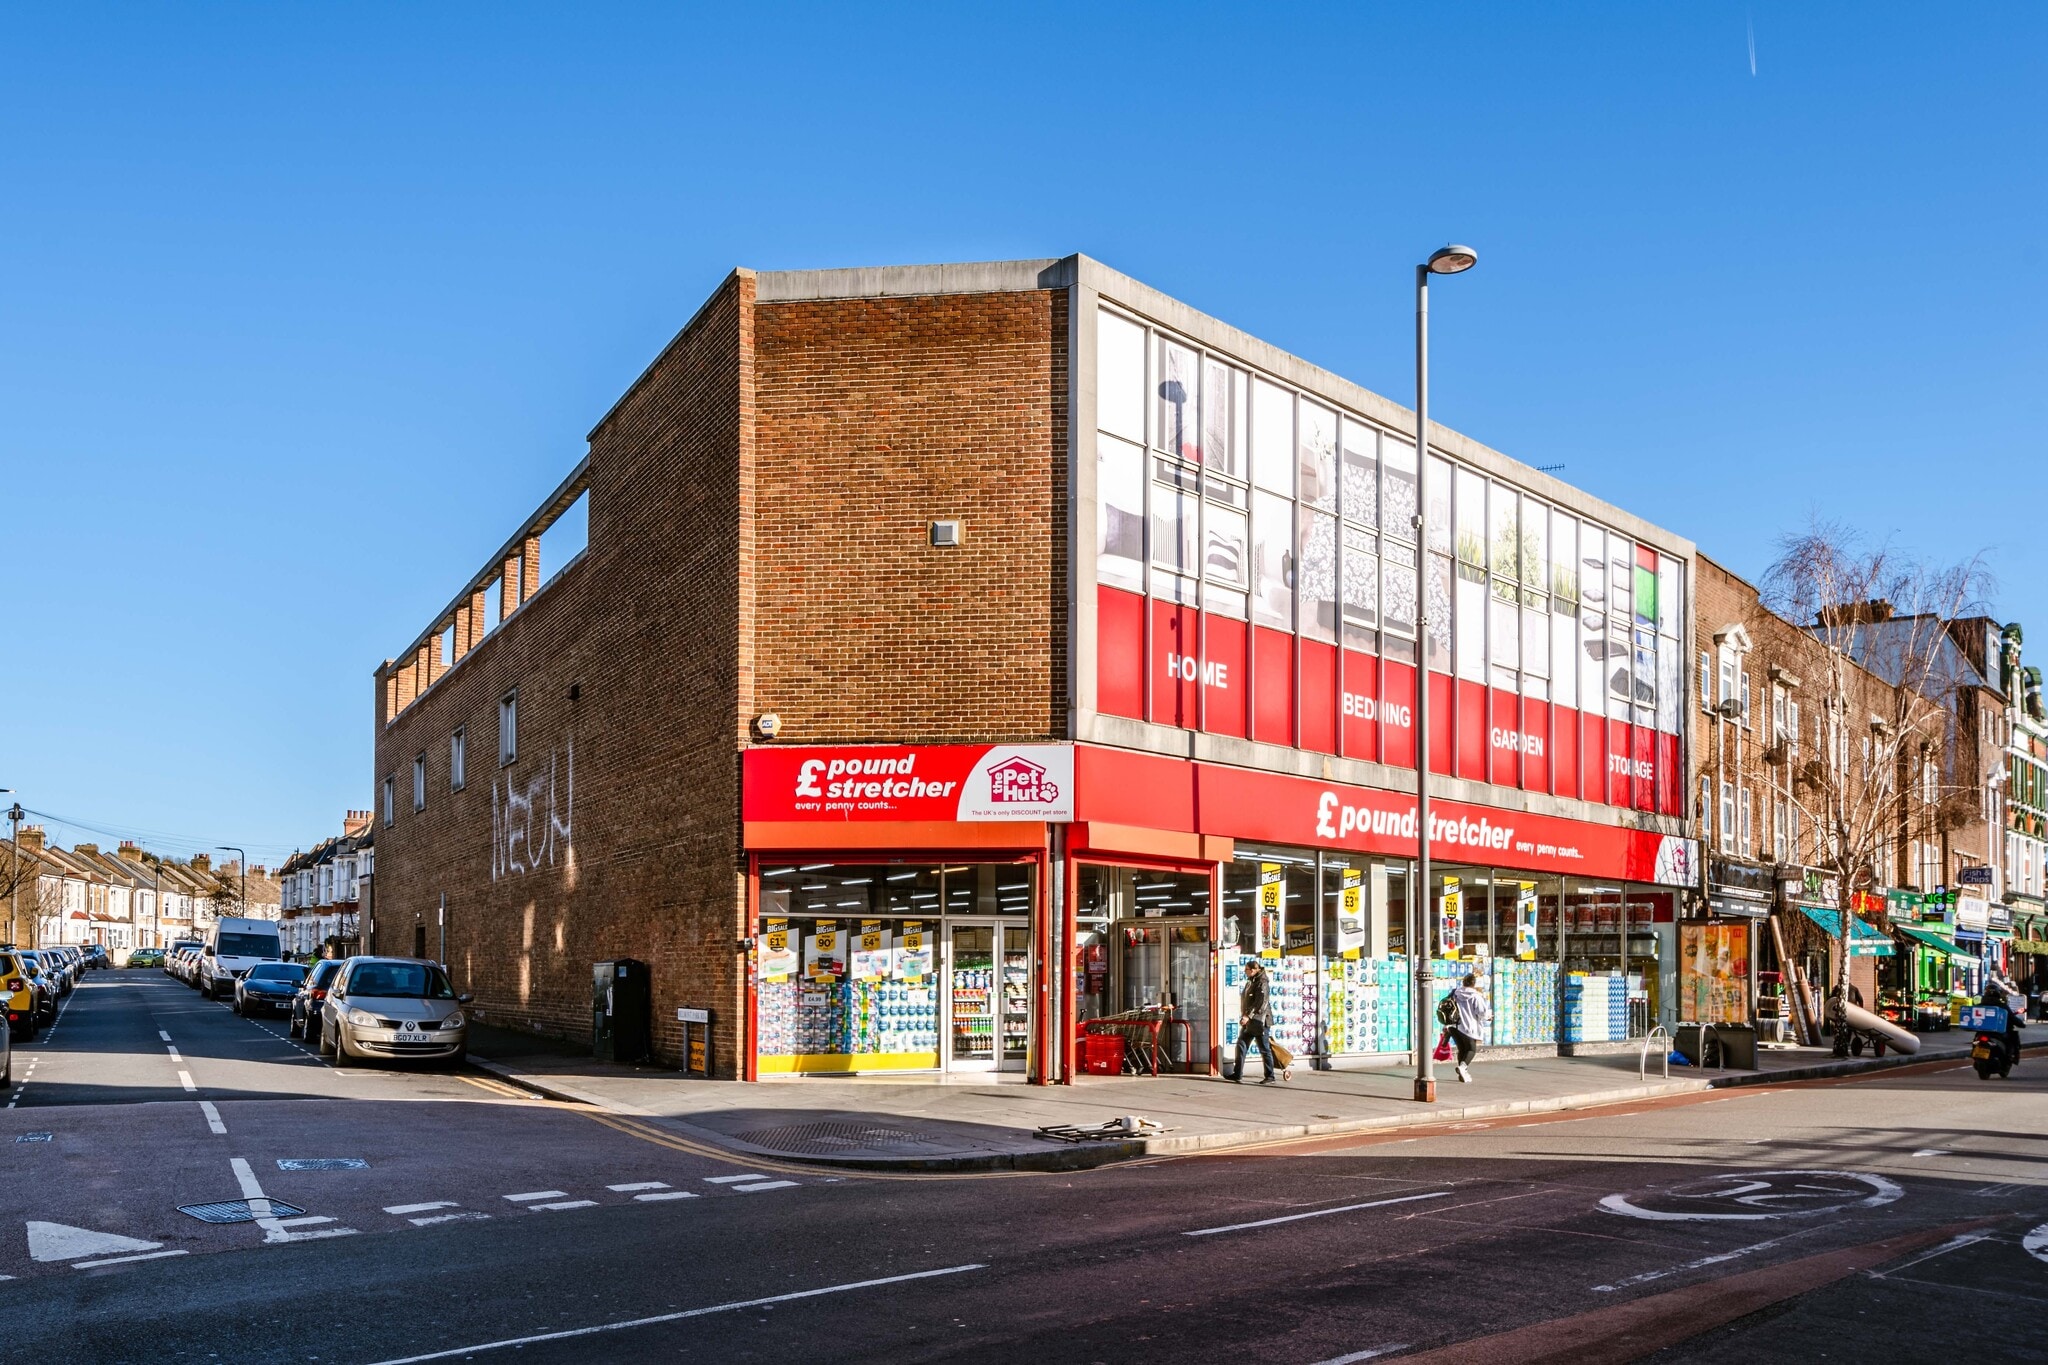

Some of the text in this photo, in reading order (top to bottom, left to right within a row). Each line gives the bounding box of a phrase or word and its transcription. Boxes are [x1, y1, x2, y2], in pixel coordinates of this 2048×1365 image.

[1167, 652, 1228, 688] HOME
[826, 753, 916, 780] pound
[992, 772, 1003, 794] the
[1003, 769, 1039, 785] Pet
[826, 777, 957, 798] stretcher
[1003, 785, 1039, 801] Hut
[795, 800, 897, 811] every penny counts...
[1339, 804, 1514, 850] poundtretcher
[1516, 841, 1534, 856] every
[1537, 844, 1557, 858] penny
[767, 925, 778, 933] BIG
[816, 926, 826, 934] BIG
[1388, 935, 1404, 948] SALE
